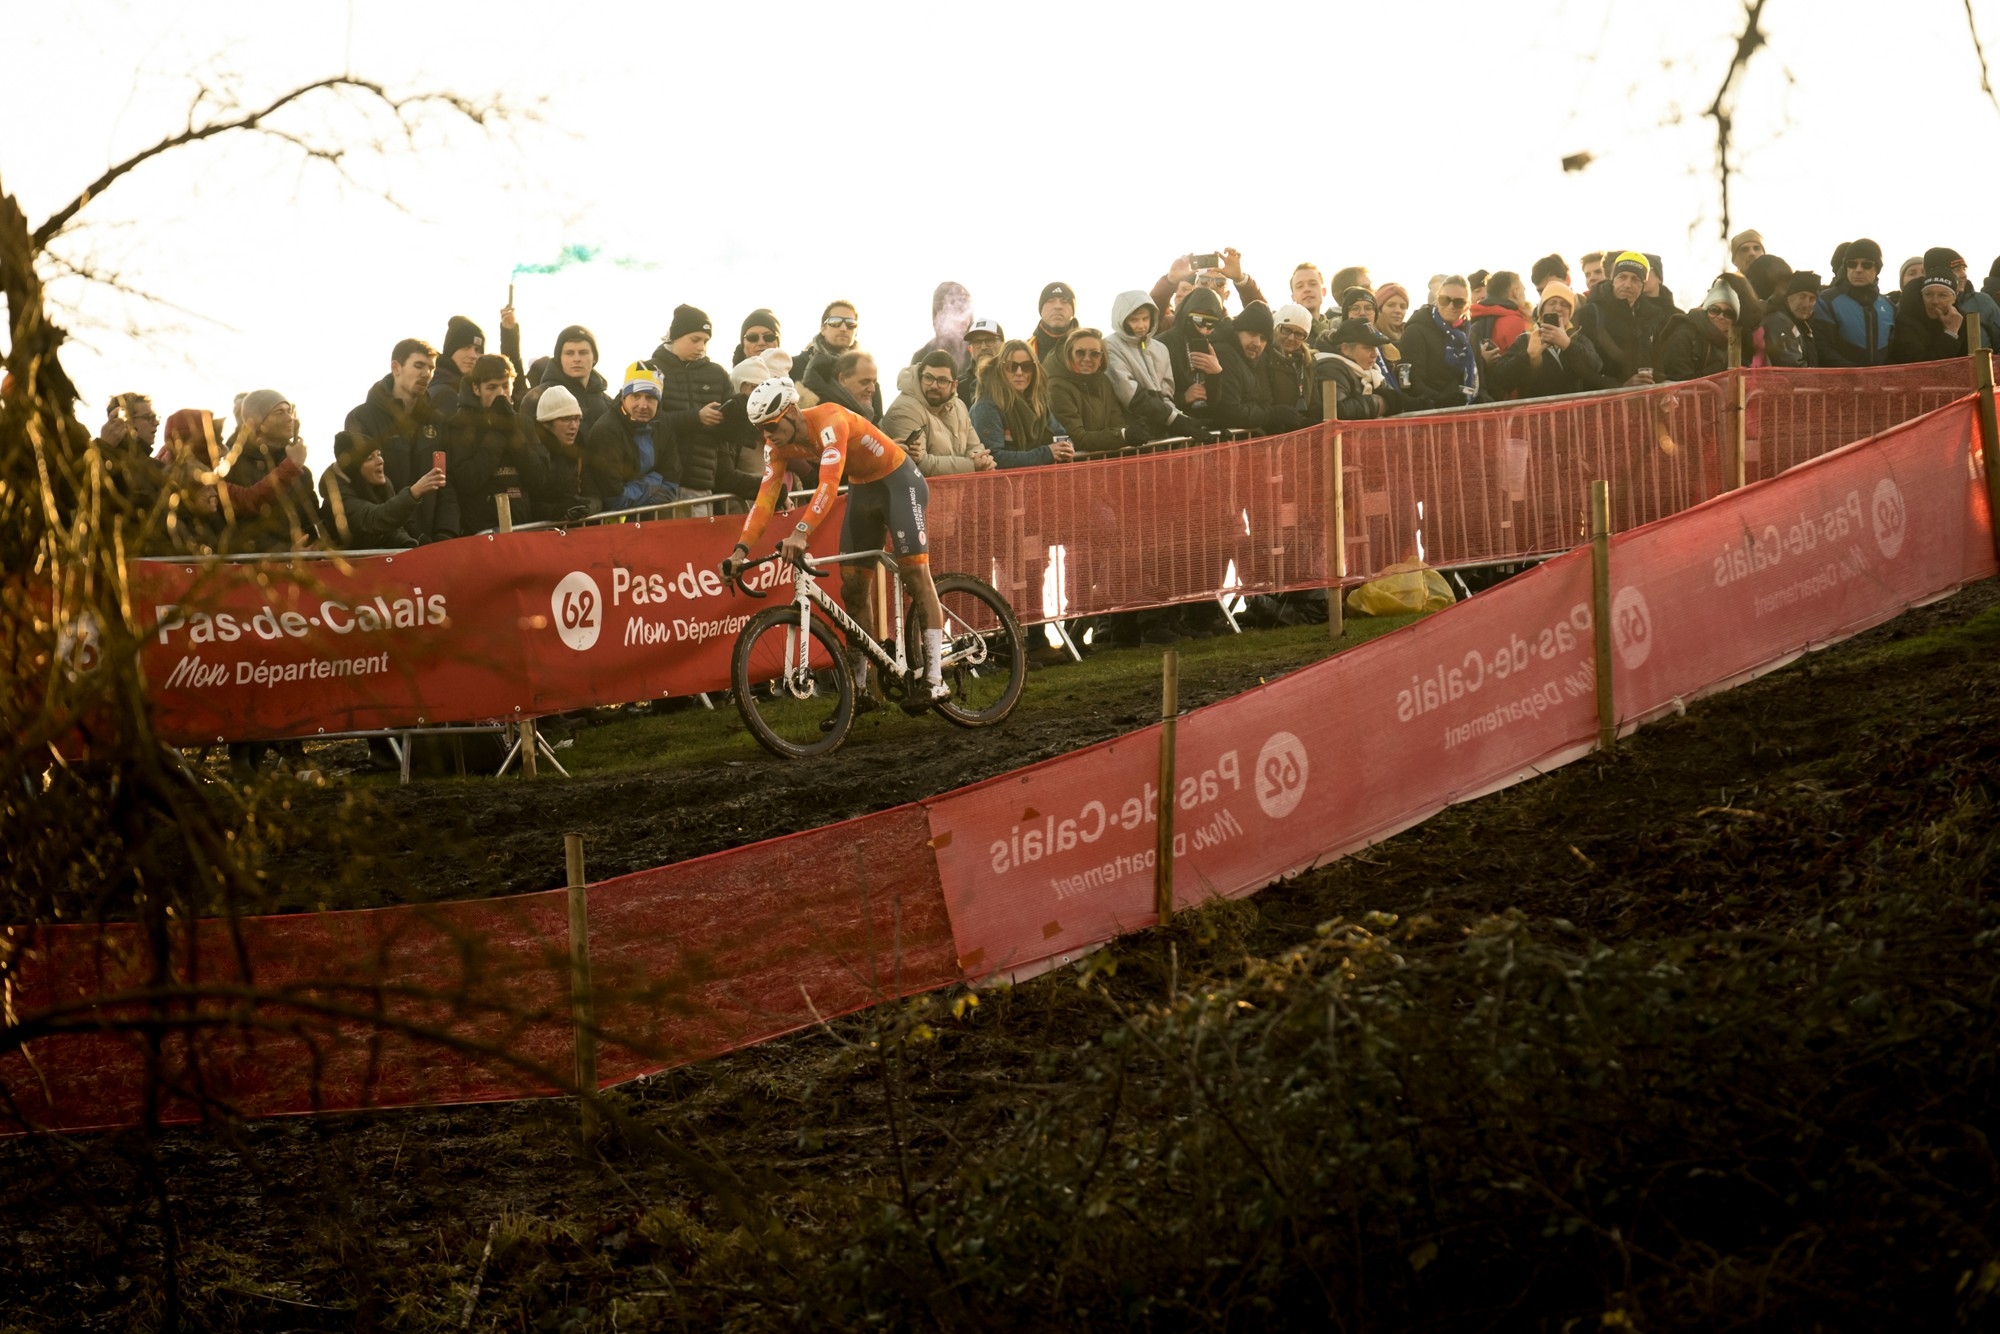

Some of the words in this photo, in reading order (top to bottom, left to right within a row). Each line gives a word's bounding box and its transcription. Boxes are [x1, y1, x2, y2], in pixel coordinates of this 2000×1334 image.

[562, 590, 594, 630] 62
[624, 616, 671, 647] Mon
[673, 614, 757, 645] Départem
[164, 656, 229, 689] Mon
[235, 652, 389, 688] Département
